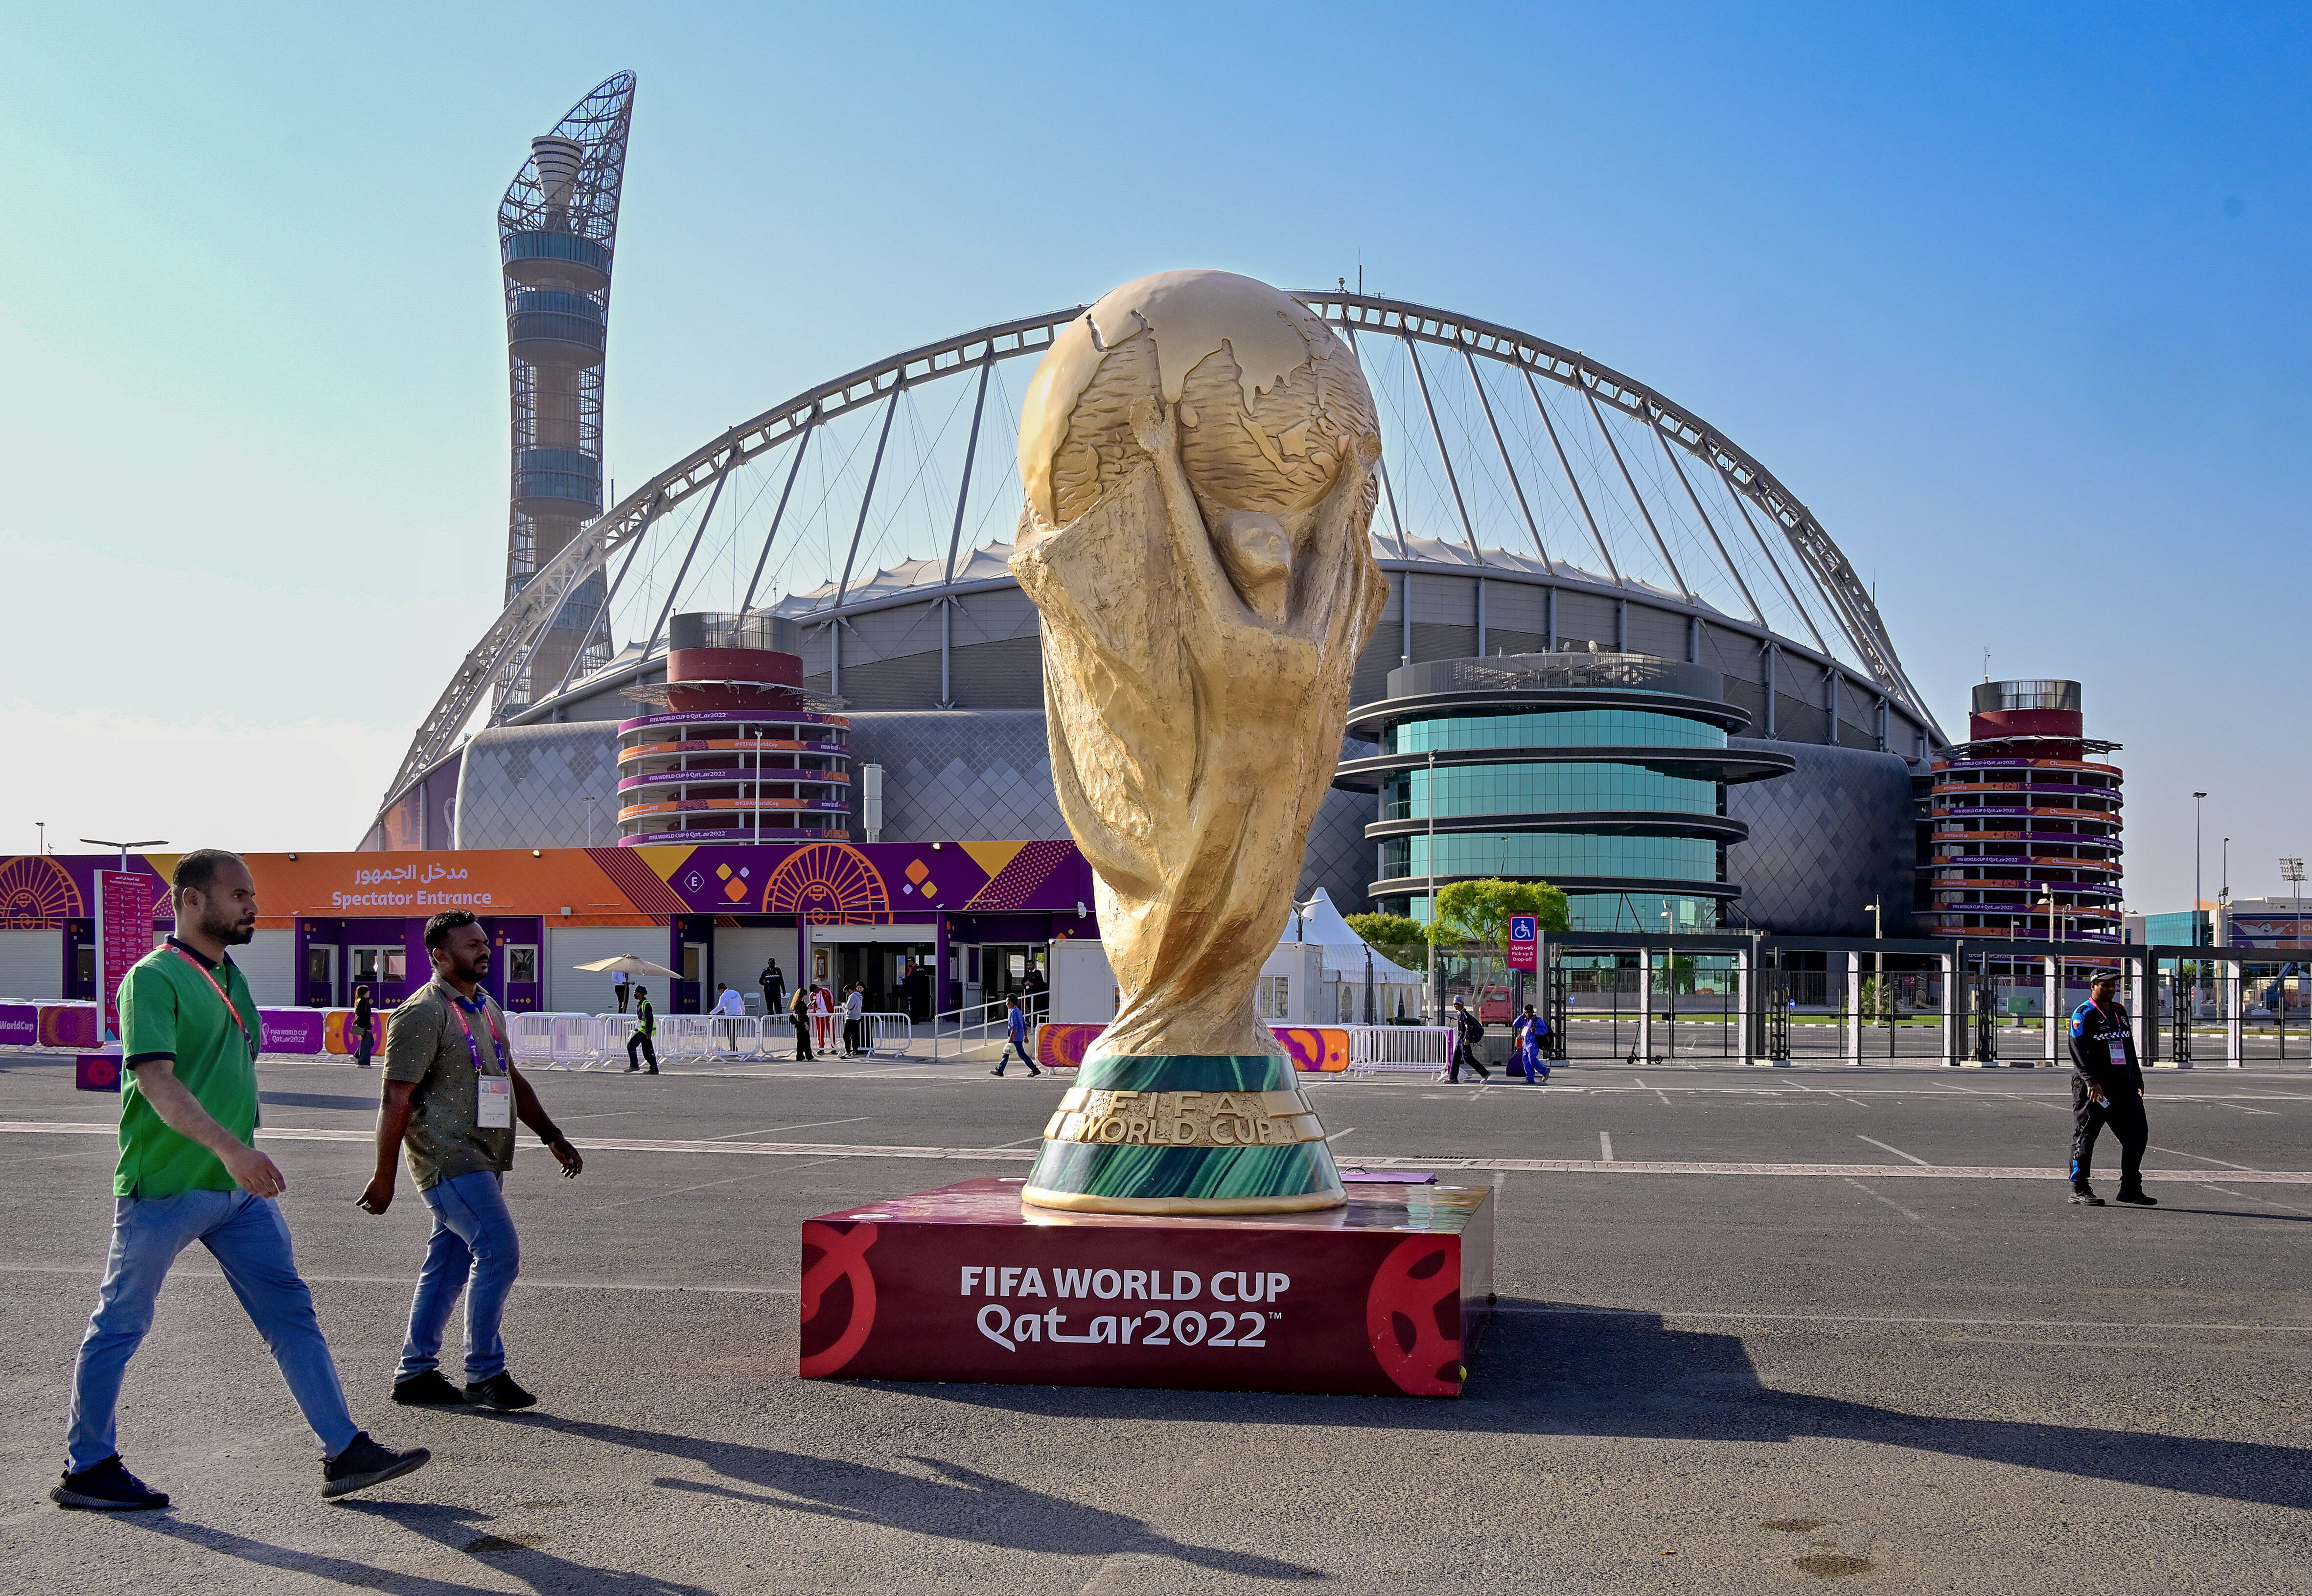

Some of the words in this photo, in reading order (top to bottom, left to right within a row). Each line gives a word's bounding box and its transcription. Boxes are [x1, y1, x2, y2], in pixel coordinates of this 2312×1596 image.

[355, 865, 416, 885] الجمهور
[420, 862, 468, 884] مدخل
[692, 877, 698, 886] E
[332, 891, 413, 910] Spectator
[417, 890, 491, 905] Entrance
[1107, 1090, 1245, 1118] FIFA
[1077, 1115, 1199, 1145] WORLD
[1209, 1118, 1272, 1144] CUP
[961, 1266, 1047, 1298] FIFA
[1053, 1268, 1201, 1300] WORLD
[1210, 1272, 1290, 1302] CUP
